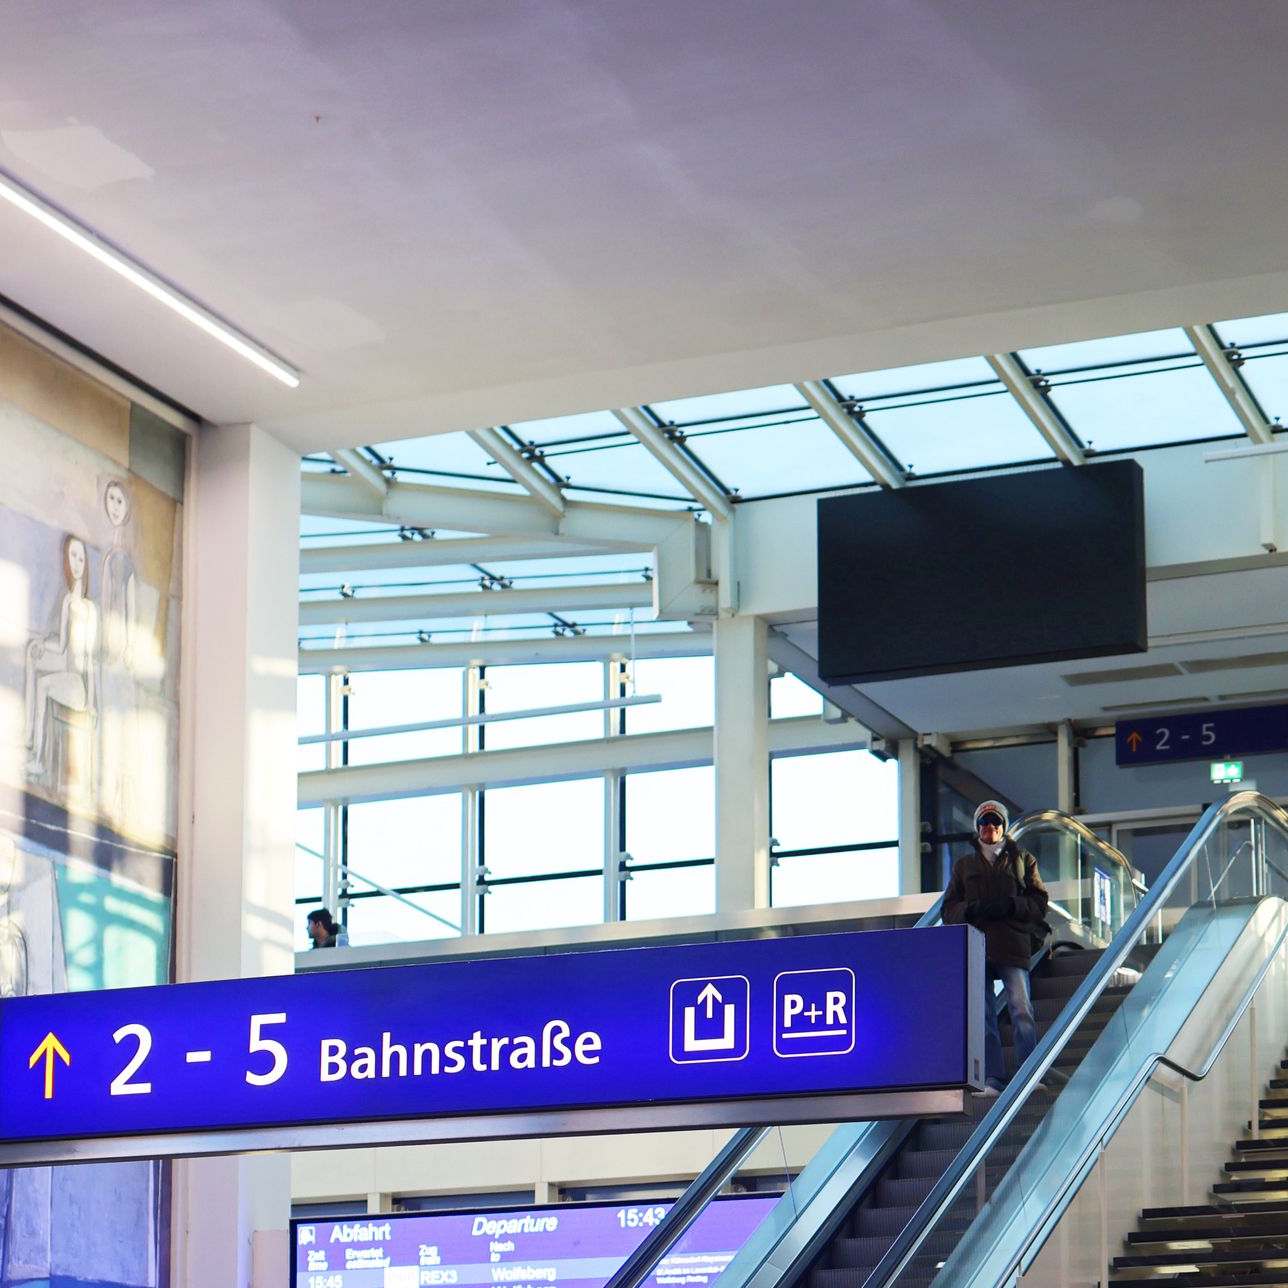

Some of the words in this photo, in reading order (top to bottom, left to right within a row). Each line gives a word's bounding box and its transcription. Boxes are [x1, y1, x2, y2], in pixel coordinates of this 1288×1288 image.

[1155, 727, 1171, 750] 2
[1200, 722, 1216, 746] 5
[783, 990, 848, 1029] P+R
[109, 1023, 153, 1096] 2
[244, 1012, 289, 1087] 5
[319, 1018, 603, 1083] Bahnstraße
[329, 1222, 392, 1244] Abfahrt
[471, 1215, 558, 1238] Departure
[420, 1270, 458, 1286] REX3
[490, 1266, 557, 1283] Wolfsberg
